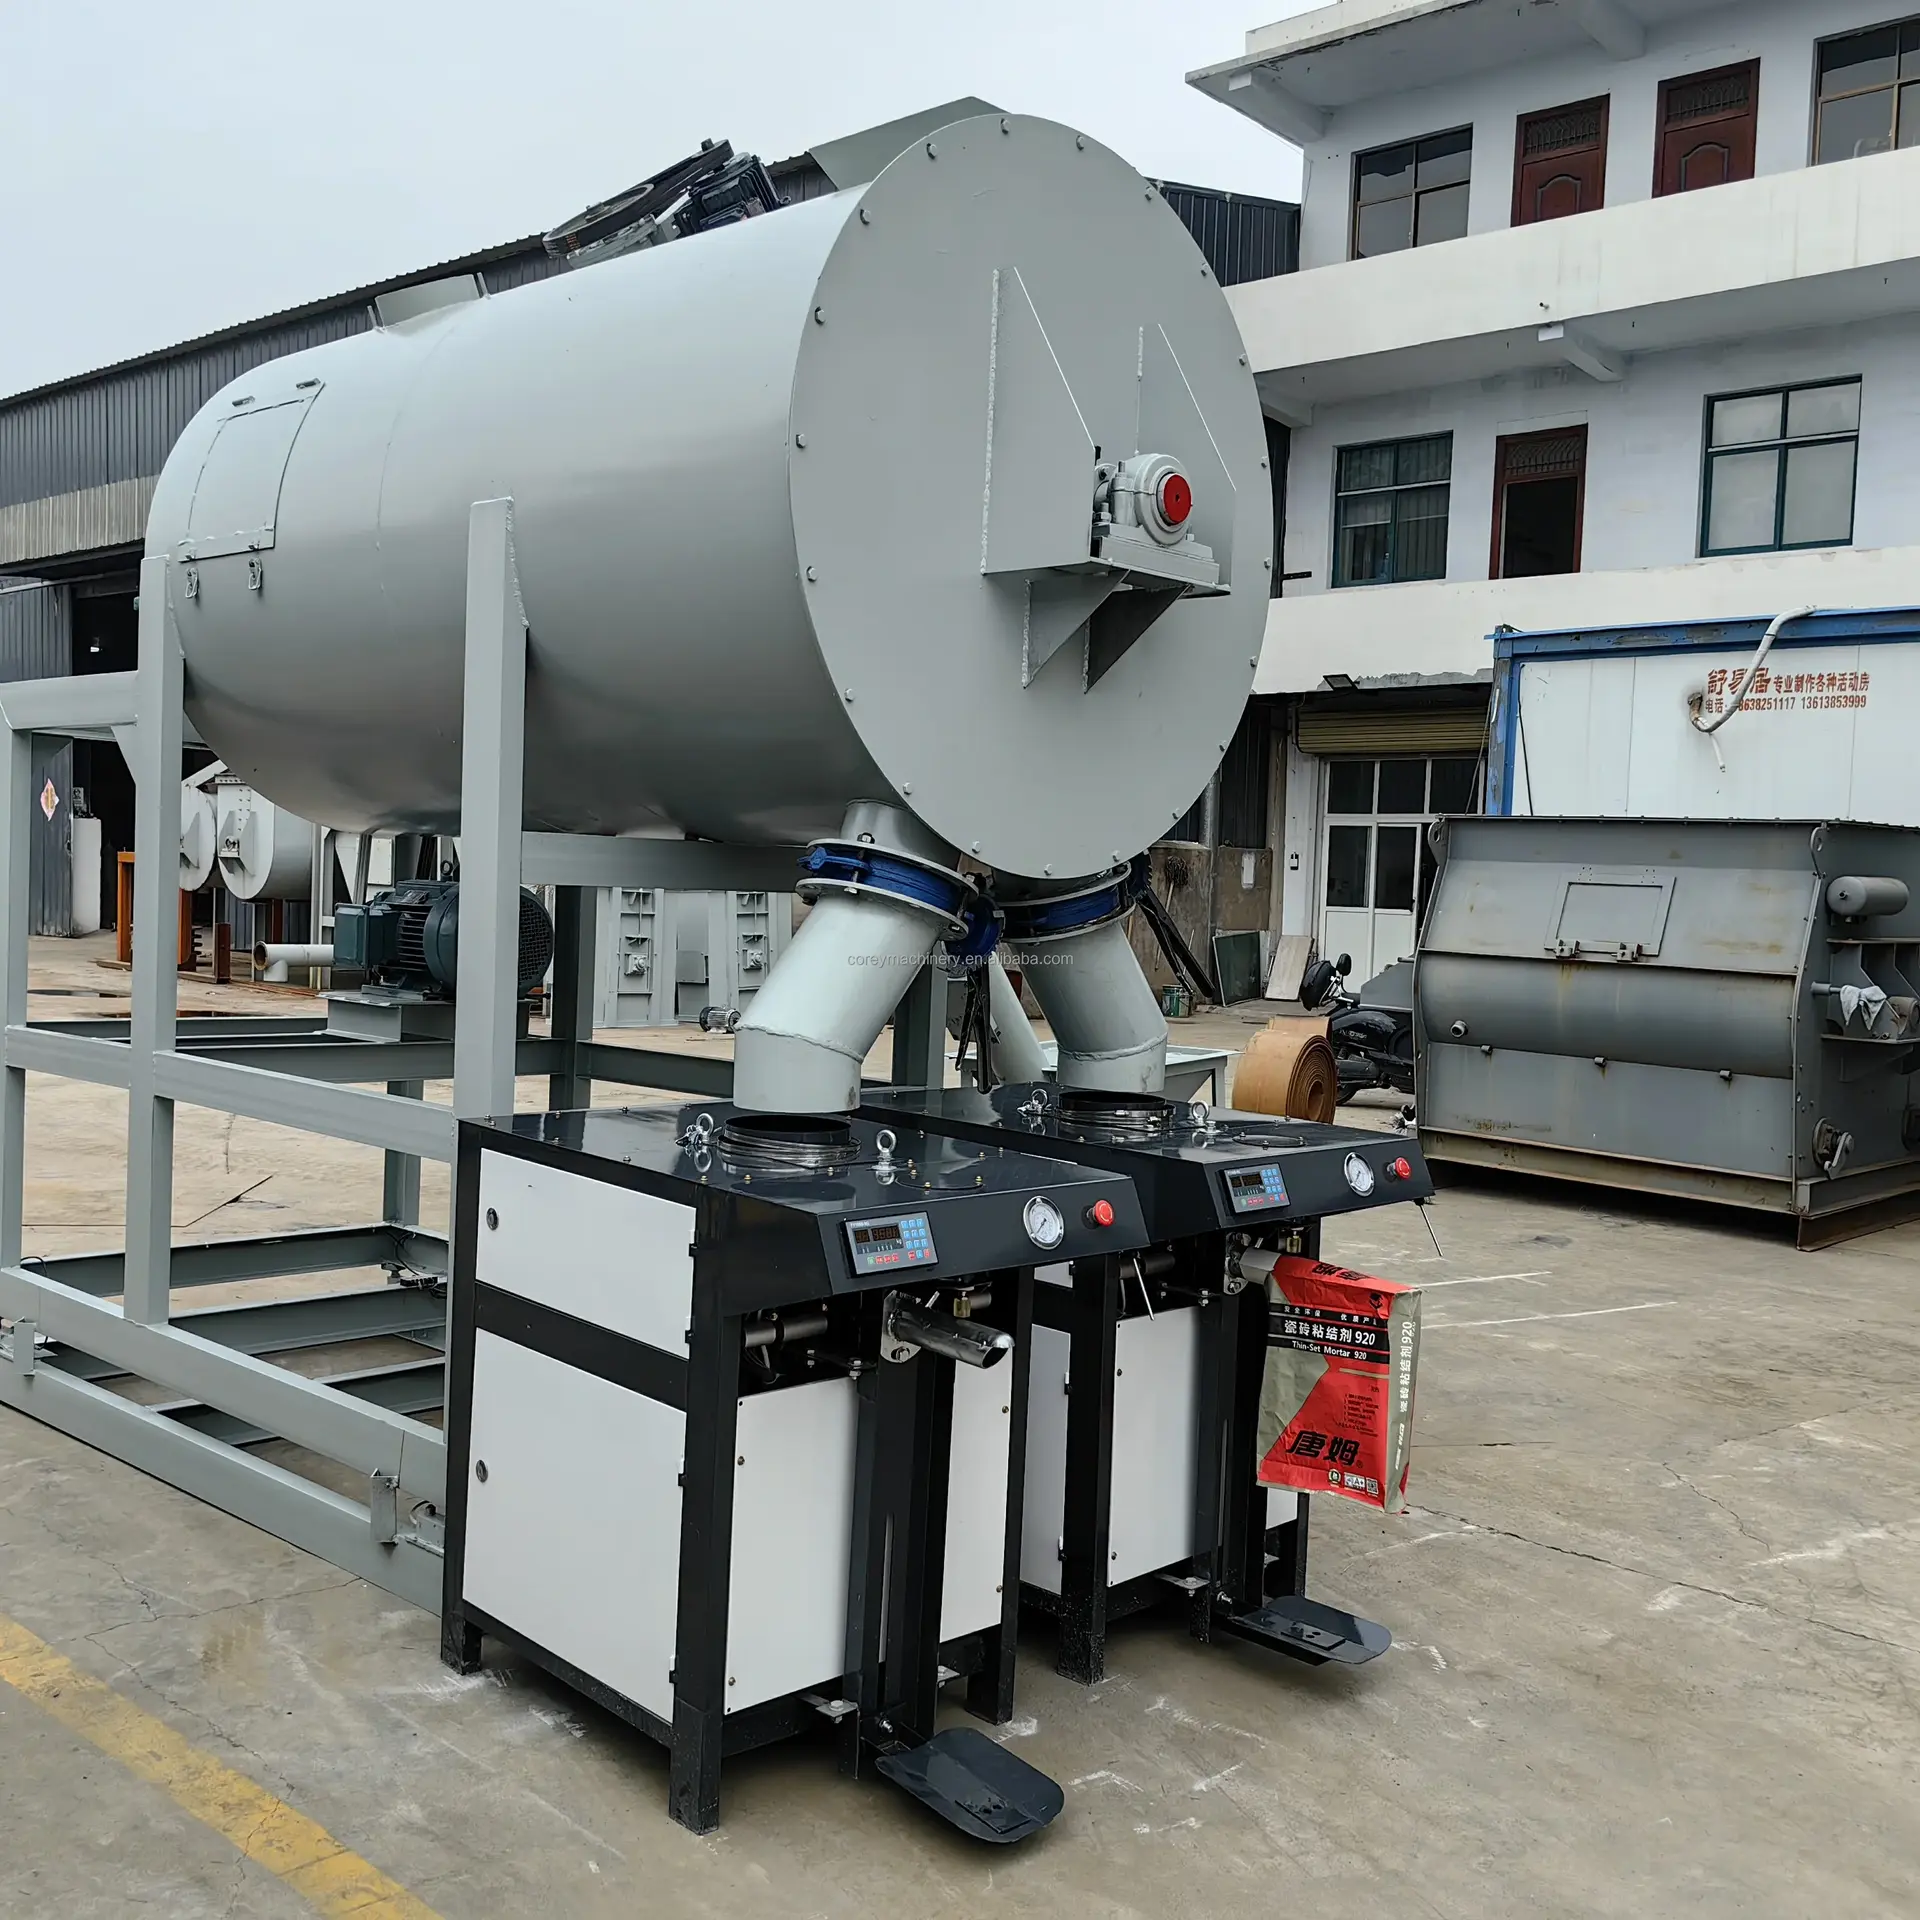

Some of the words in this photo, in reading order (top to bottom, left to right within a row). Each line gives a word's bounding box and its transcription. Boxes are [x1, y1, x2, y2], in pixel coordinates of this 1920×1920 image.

[1773, 671, 1870, 694] 专业制作各种活动房
[1737, 697, 1795, 711] 8638251117
[1801, 695, 1867, 710] 13613853999
[1284, 1319, 1352, 1343] 瓷砖粘结剂
[1354, 1331, 1376, 1346] 920
[1292, 1340, 1321, 1353] Thin-Set
[1323, 1346, 1351, 1358] Mortar
[1354, 1351, 1367, 1360] 920
